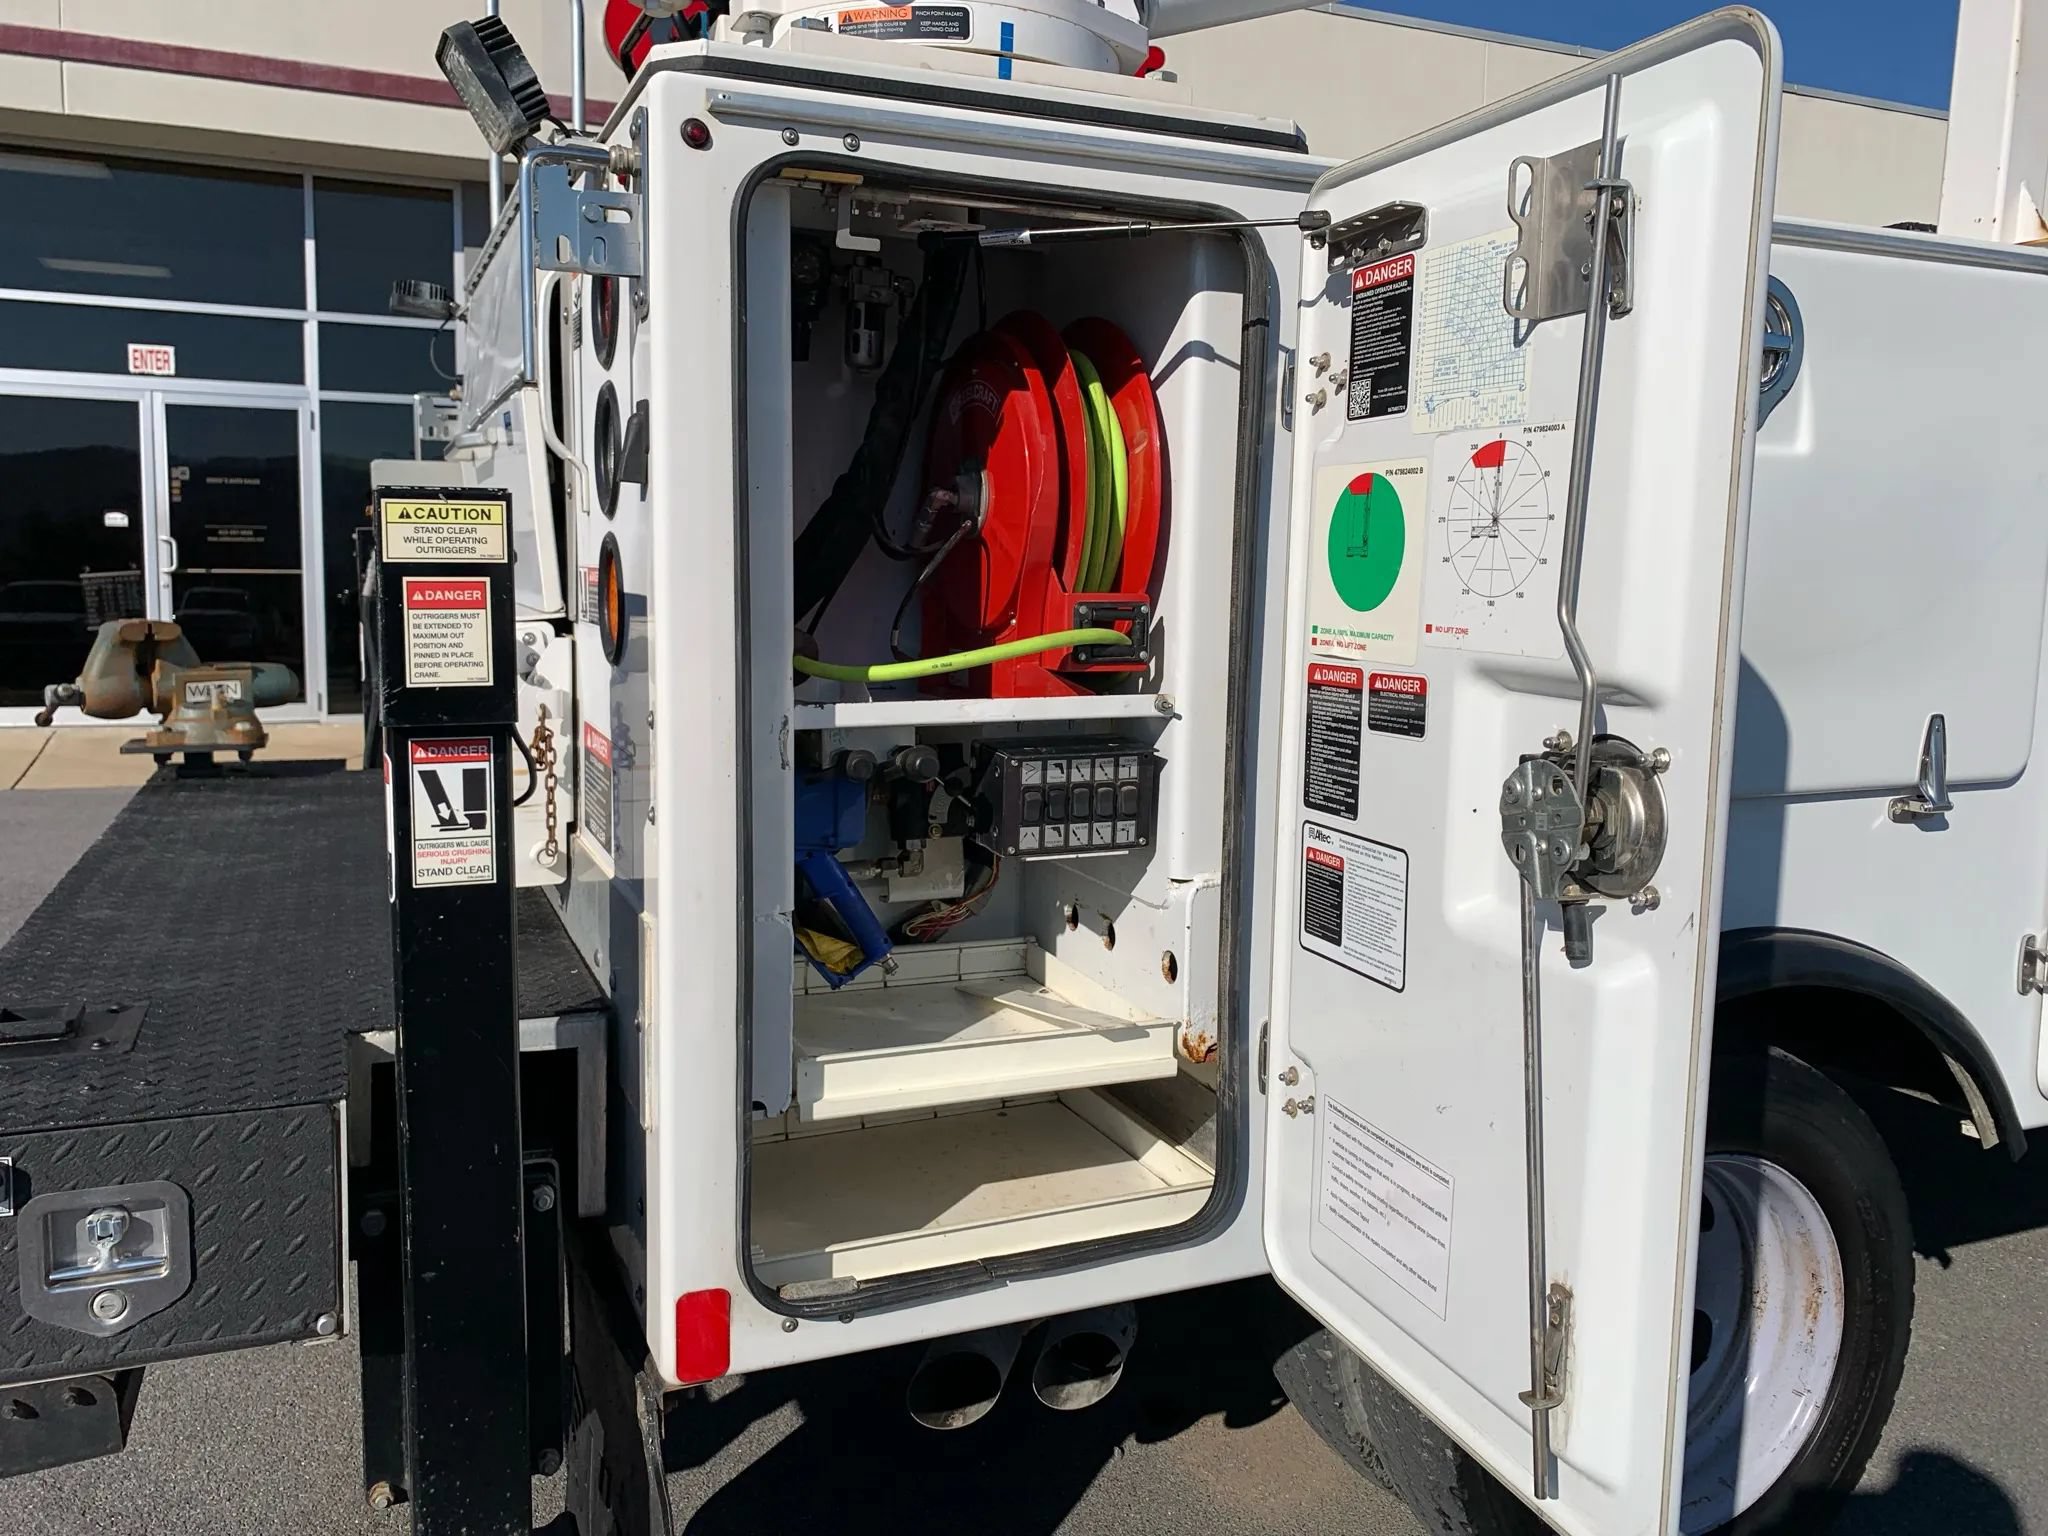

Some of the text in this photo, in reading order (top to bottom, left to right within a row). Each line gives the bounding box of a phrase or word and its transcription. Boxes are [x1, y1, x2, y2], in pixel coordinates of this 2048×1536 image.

[854, 8, 908, 20] WARNING
[1365, 258, 1412, 286] DANGER
[132, 348, 171, 371] ENTER
[413, 507, 491, 520] CAUTION
[403, 536, 488, 544] WHILE OPERATING
[415, 546, 477, 554] OUTRIGGERS
[425, 590, 482, 601] DANGER
[1349, 630, 1371, 639] MAXIMUM
[1371, 632, 1394, 641] CAPACITY
[1444, 626, 1454, 634] LIFT
[1455, 627, 1469, 635] ZONE
[1354, 643, 1367, 651] ZONE
[443, 660, 484, 668] OPERATING
[1322, 669, 1357, 684] DANGER
[1381, 677, 1421, 693] DANGER
[427, 744, 488, 758] DANGER
[1314, 829, 1332, 845] Altec
[417, 839, 490, 850] OUTRIGGERS WILL CAUSE
[416, 848, 491, 859] SERIOUS CRUSHING
[440, 857, 468, 865] INJURY
[1315, 851, 1341, 868] DANGER
[418, 865, 491, 878] STAND CLEAR
